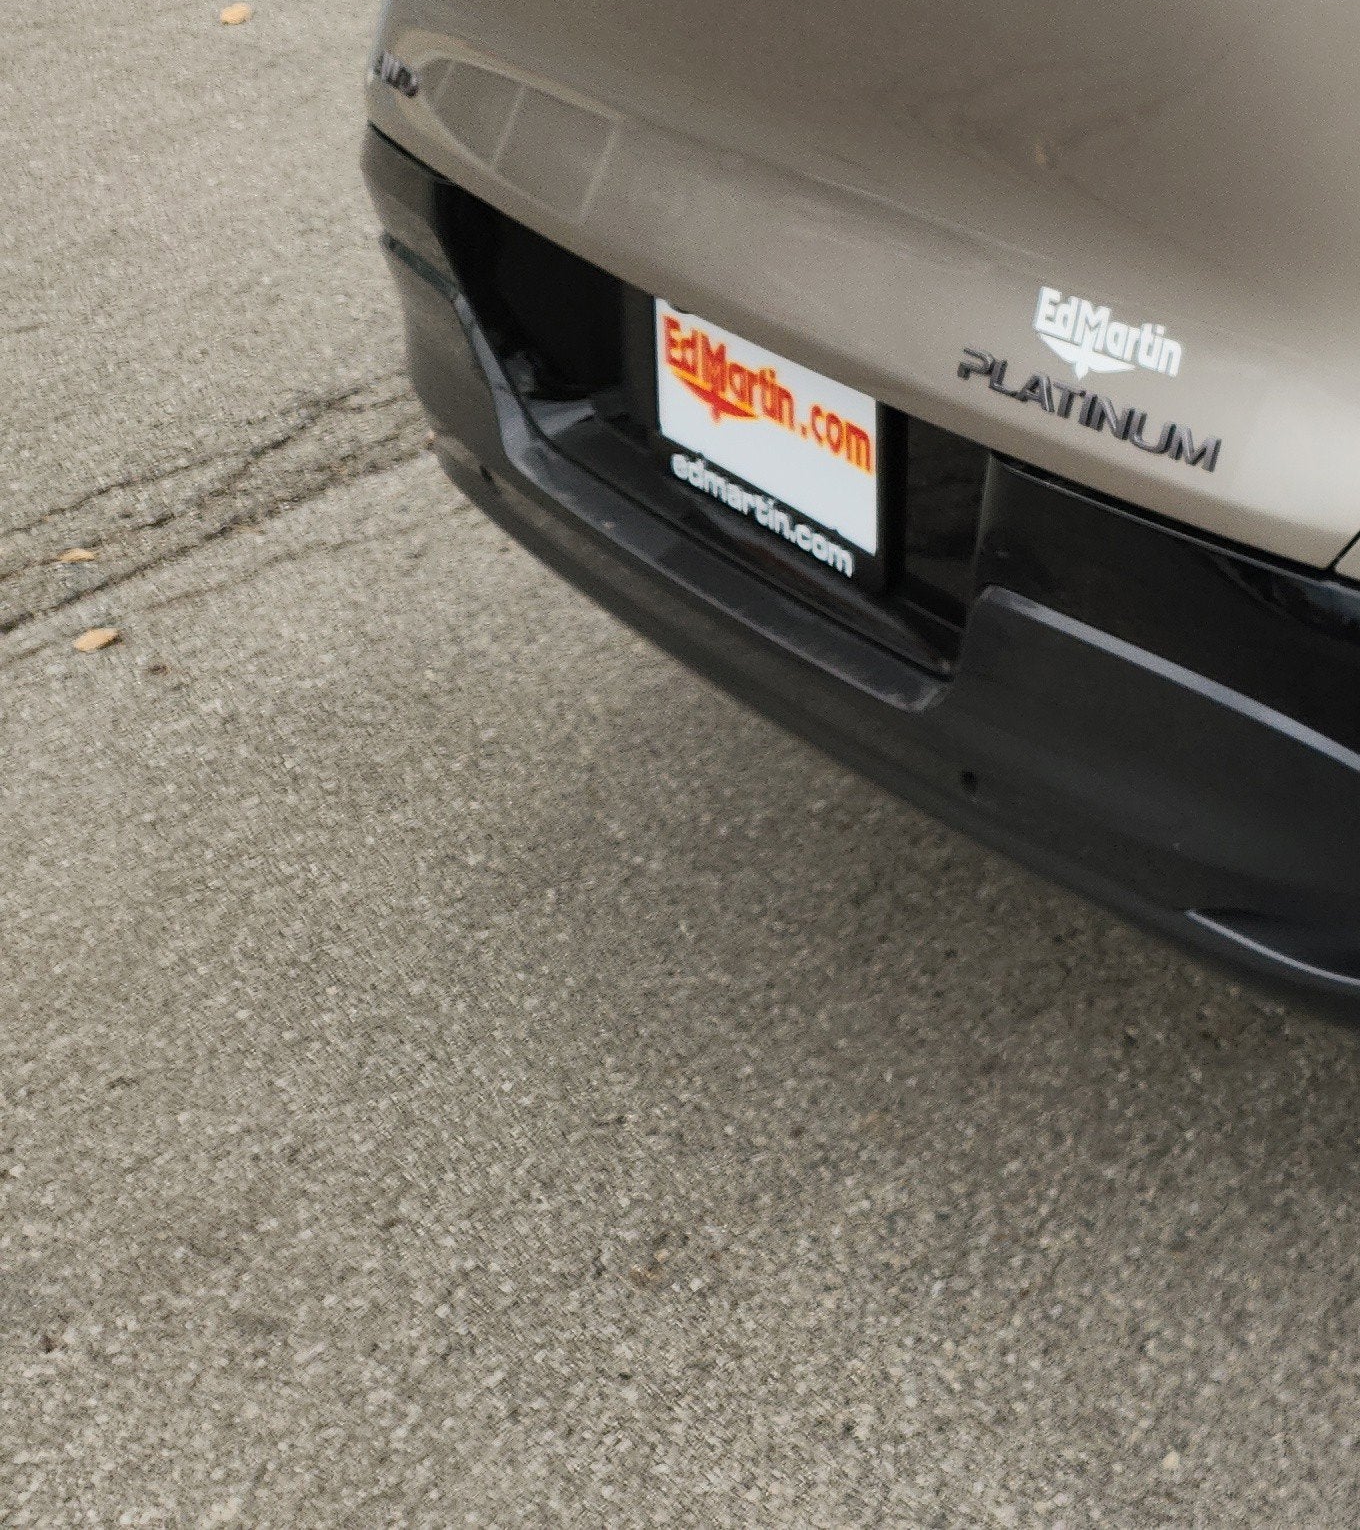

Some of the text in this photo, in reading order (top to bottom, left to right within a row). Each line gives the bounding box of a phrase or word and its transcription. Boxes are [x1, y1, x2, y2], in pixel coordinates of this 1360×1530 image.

[1034, 285, 1182, 378] EdMartin
[956, 346, 1223, 473] PLATINUM
[671, 452, 855, 578] edmartin.com
